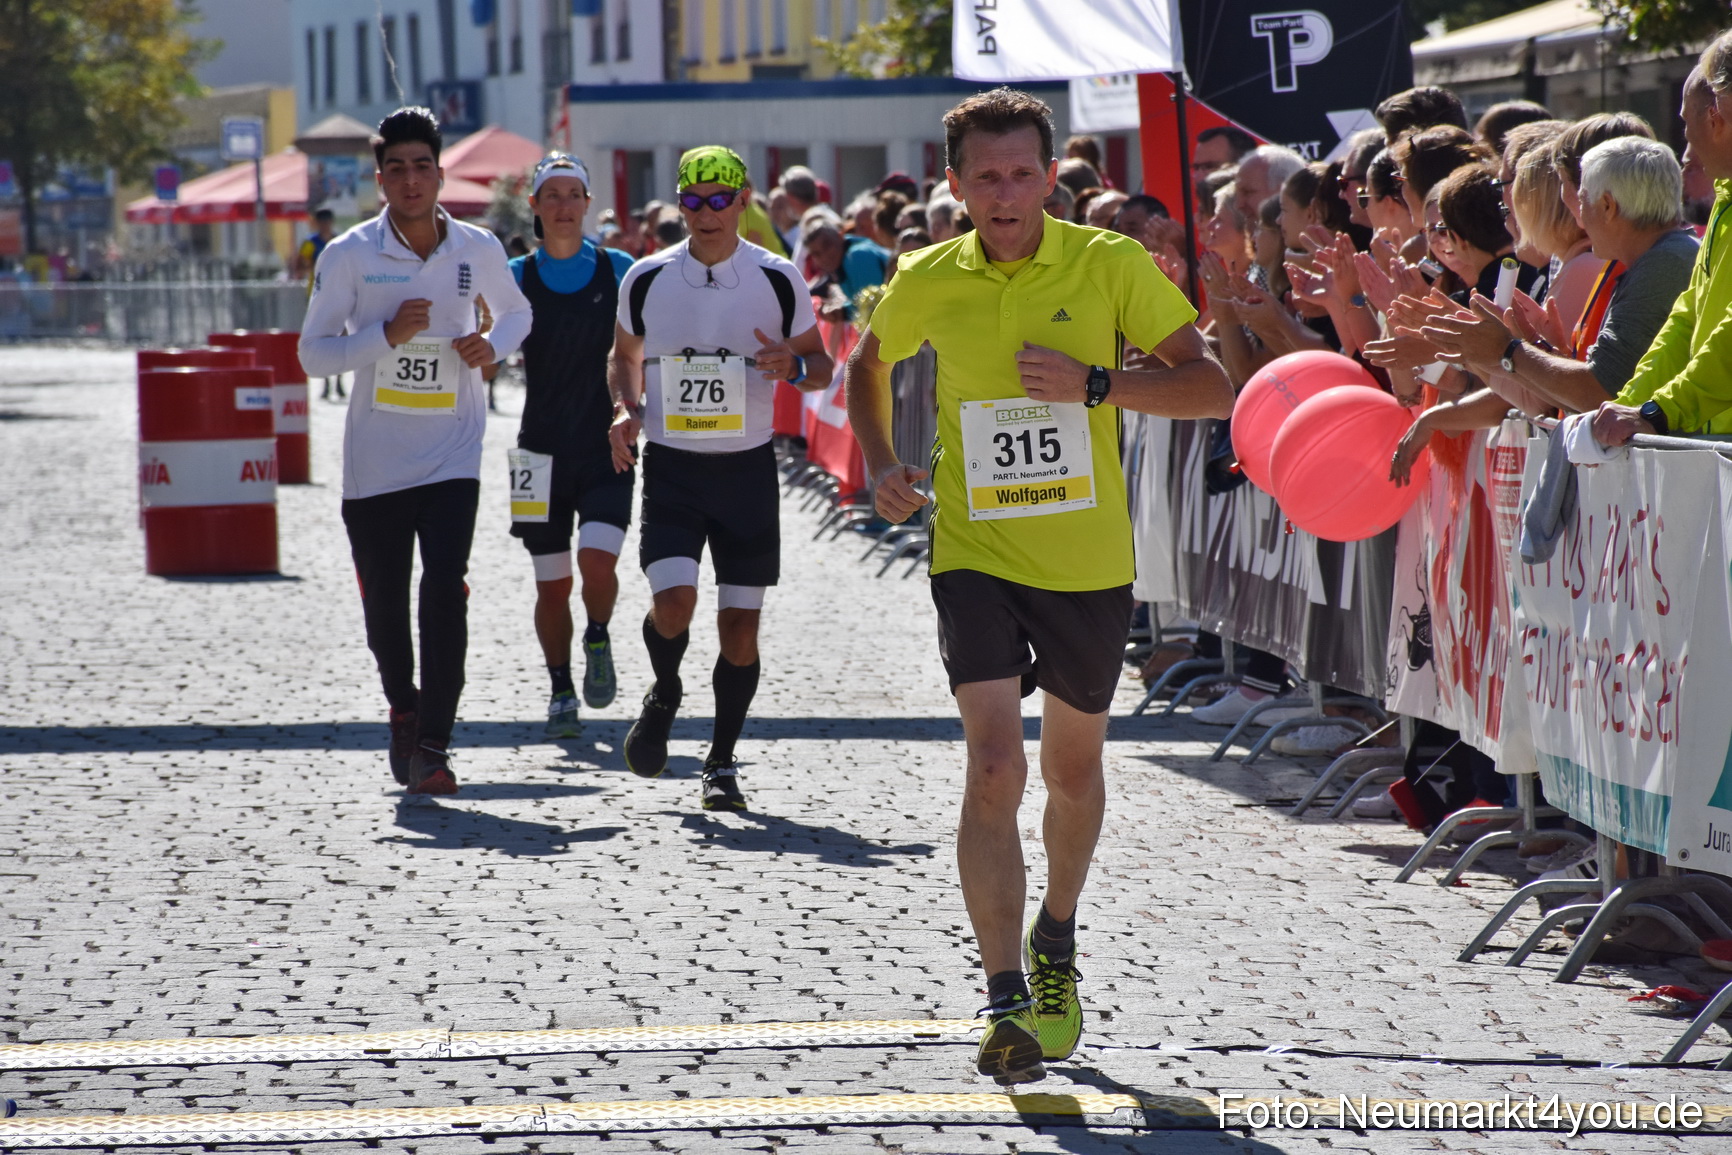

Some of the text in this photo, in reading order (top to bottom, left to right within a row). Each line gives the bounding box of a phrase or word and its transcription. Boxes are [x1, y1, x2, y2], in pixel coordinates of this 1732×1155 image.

[1257, 20, 1281, 30] Team
[362, 273, 411, 284] Waitrose
[396, 357, 439, 382] 351
[680, 379, 725, 404] 276
[996, 405, 1051, 421] BOCK
[686, 418, 718, 429] Rainer
[993, 427, 1062, 468] 315
[993, 469, 1057, 481] PARTL Neumarkt
[996, 486, 1066, 504] Wolfgang
[1703, 822, 1731, 854] Jura
